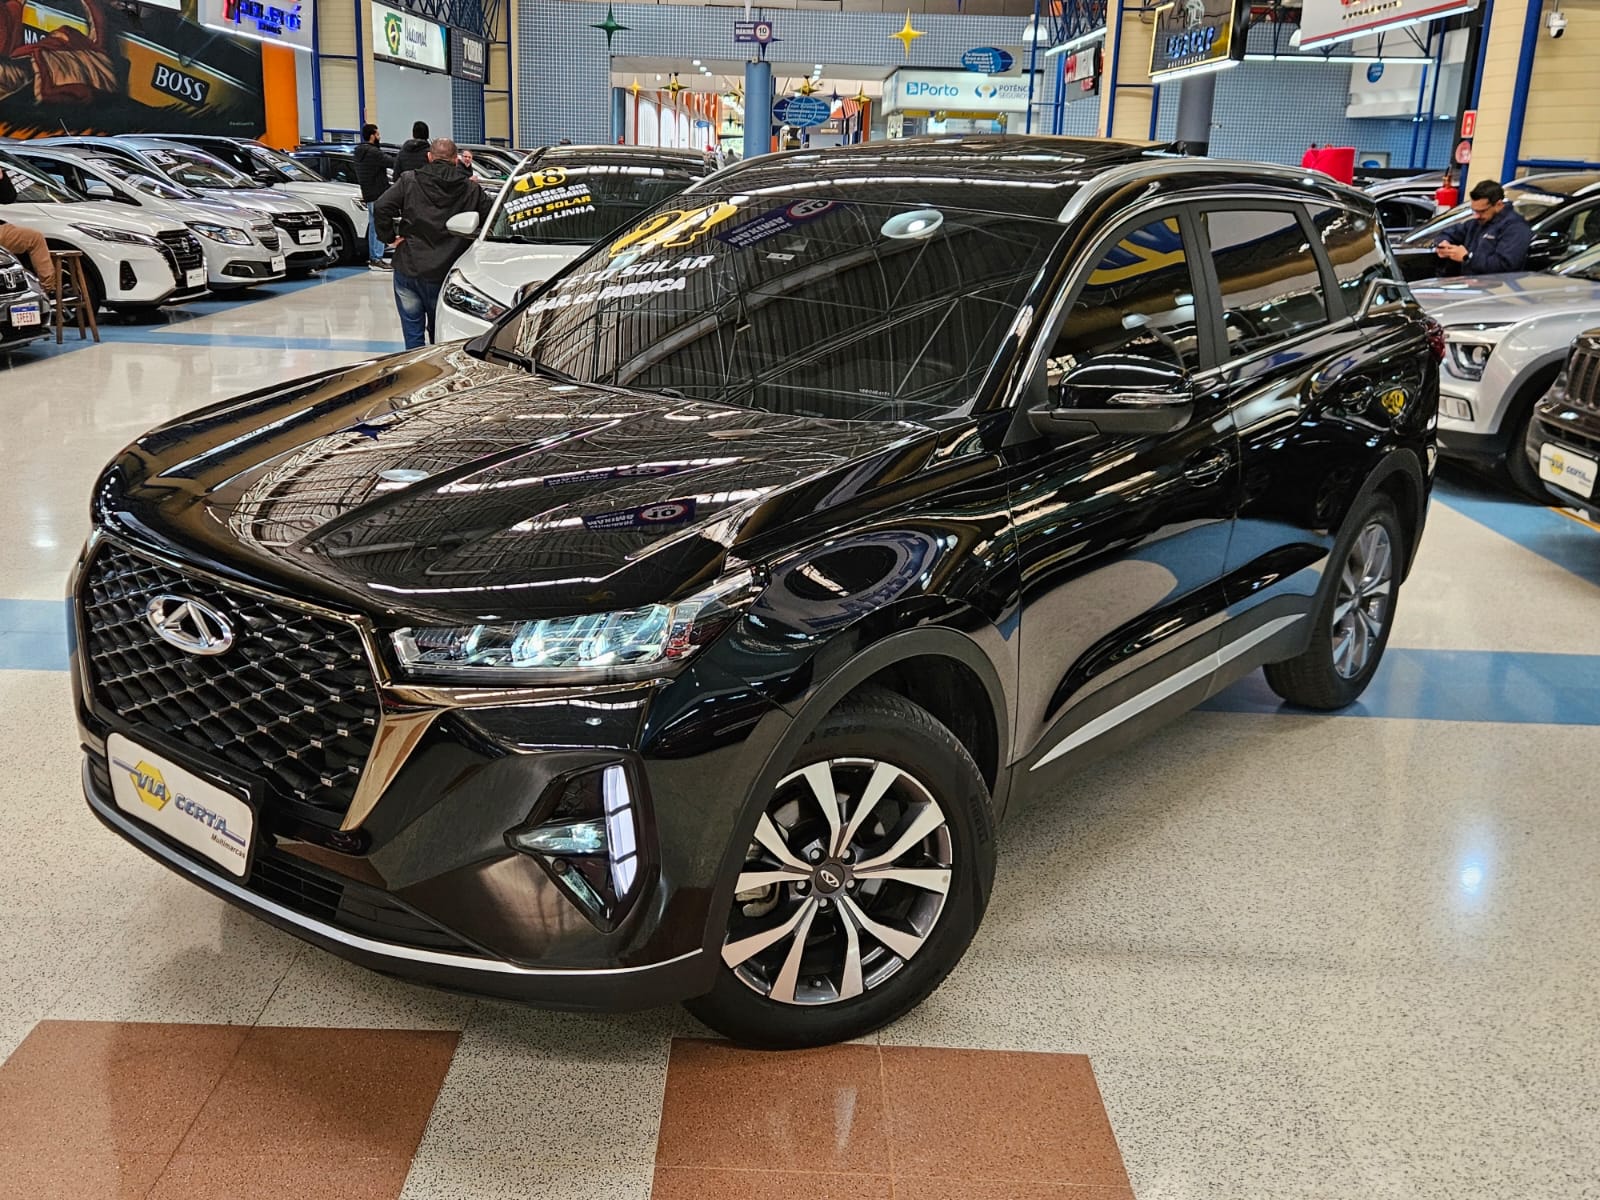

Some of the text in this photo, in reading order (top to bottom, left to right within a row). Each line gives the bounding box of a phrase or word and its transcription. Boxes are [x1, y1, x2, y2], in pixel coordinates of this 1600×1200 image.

[758, 26, 768, 34] 10
[155, 65, 206, 102] BOSS
[920, 82, 959, 97] Porto
[508, 195, 592, 223] TETO SOLAR
[510, 217, 539, 231] TOP
[553, 204, 596, 219] LINHA
[551, 255, 715, 292] TETO SOLAR
[137, 771, 166, 801] VIA
[174, 792, 227, 834] CERTA
[211, 832, 246, 860] Multimarcas
